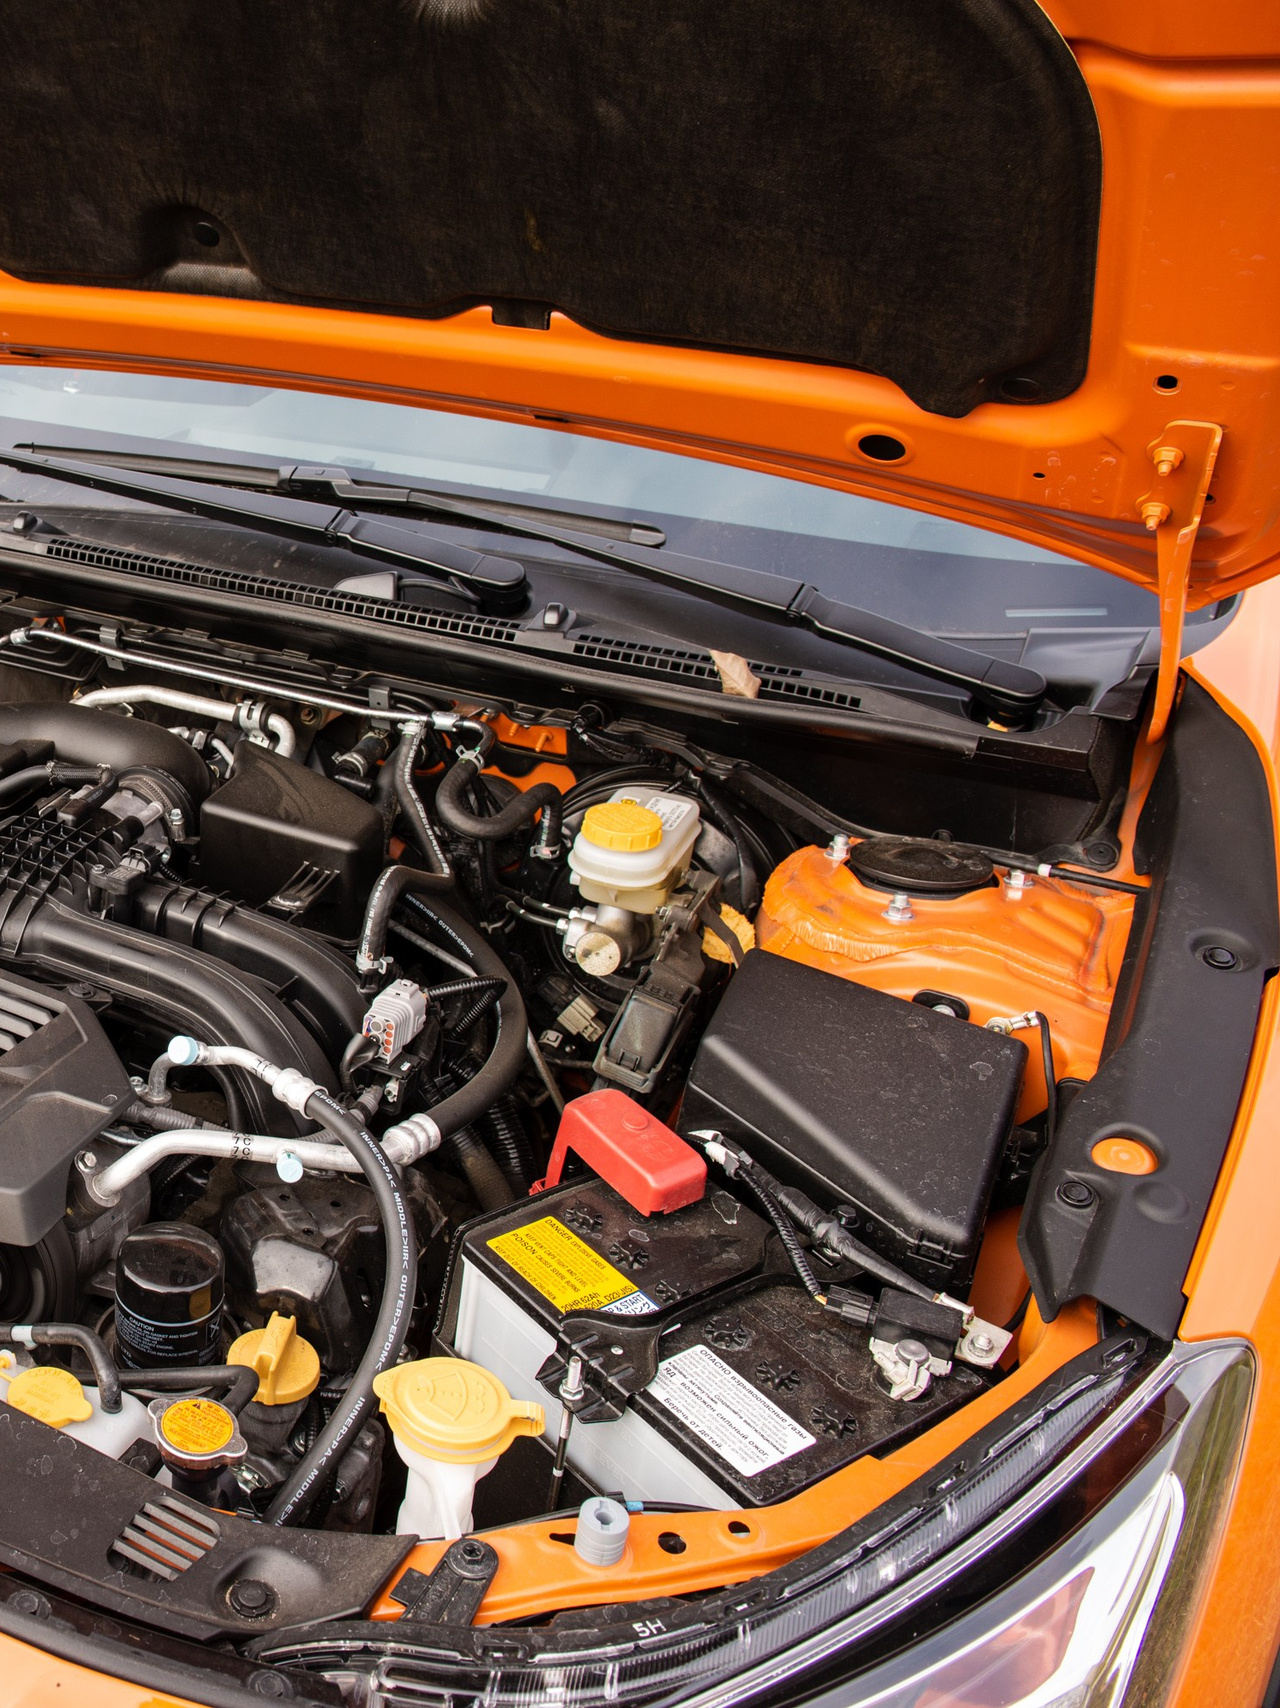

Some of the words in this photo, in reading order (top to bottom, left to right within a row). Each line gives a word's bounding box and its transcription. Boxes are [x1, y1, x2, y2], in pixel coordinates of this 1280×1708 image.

[360, 1131, 397, 1188] INNER>PA<
[393, 1192, 409, 1270] MIDDLE>IIR<
[545, 1219, 573, 1240] DANGER
[570, 1241, 593, 1258] EXPLOSIVE
[590, 1258, 607, 1269] GASES
[494, 1246, 506, 1254] KEEP
[517, 1266, 532, 1278] REACH
[535, 1283, 558, 1300] CHILDREN
[510, 1233, 538, 1254] POISON
[535, 1255, 553, 1268] CAUSES
[550, 1268, 567, 1280] SEVERE
[564, 1281, 581, 1292] BURNS
[534, 1242, 546, 1250] VENT
[544, 1250, 557, 1259] CAPS
[574, 1276, 589, 1287] LEVEL
[129, 1317, 155, 1331] CAUTION
[375, 1274, 408, 1370] OUTER>EPDM<
[561, 1298, 581, 1312] 20HR
[580, 1292, 600, 1304] 62Ah
[620, 1294, 644, 1309] START
[663, 1367, 676, 1378] ЯД
[681, 1382, 716, 1412] возможен
[717, 1412, 749, 1440] сильный
[749, 1441, 771, 1459] ожог.
[700, 1349, 731, 1375] ОПАСНО
[730, 1376, 788, 1423] взрывоопасные
[788, 1424, 807, 1439] газы
[319, 1396, 366, 1466] INNER>PA<
[664, 1398, 691, 1421] Беречь
[690, 1421, 700, 1429] от
[699, 1428, 725, 1450] детей.
[632, 1618, 667, 1637] 5H
